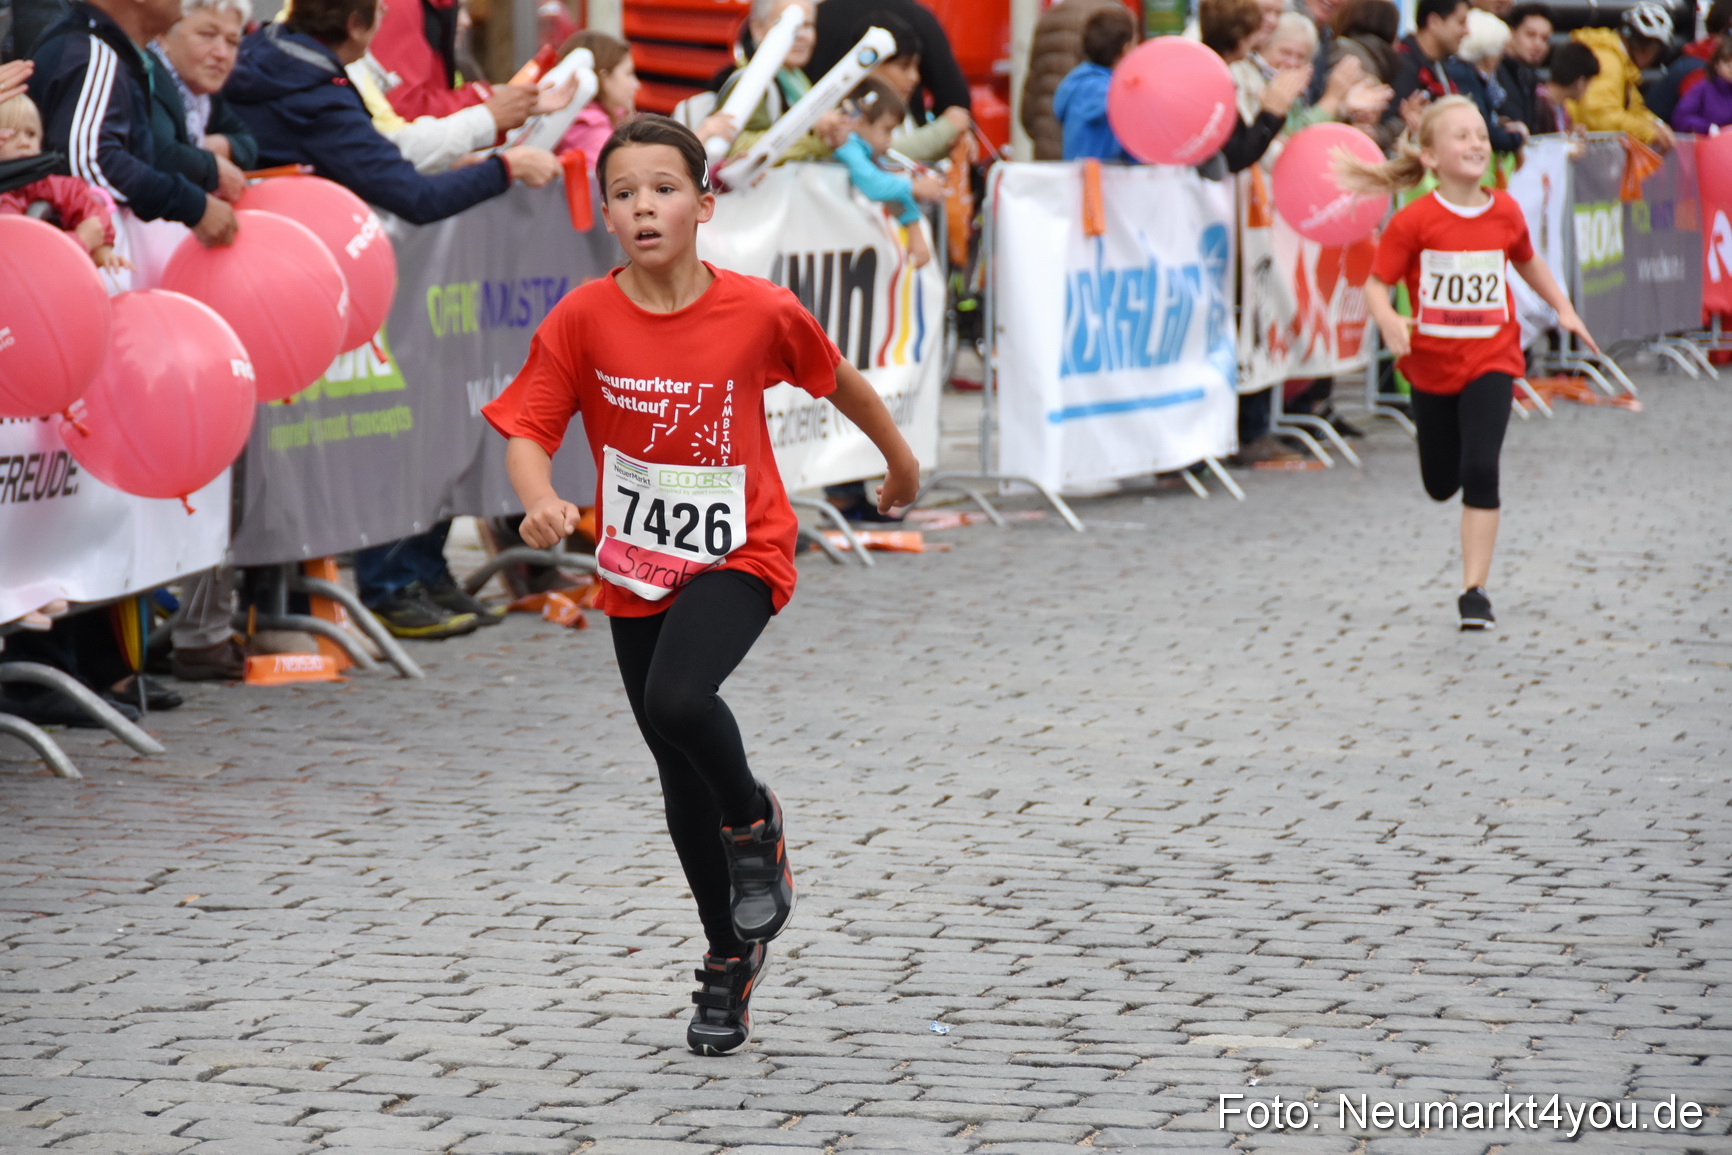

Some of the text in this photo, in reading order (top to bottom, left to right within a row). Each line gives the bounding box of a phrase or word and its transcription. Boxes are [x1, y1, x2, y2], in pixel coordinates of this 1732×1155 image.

[1430, 273, 1499, 304] 7032
[594, 368, 692, 394] Neumarkter
[601, 386, 670, 418] Stadtlauf
[720, 379, 734, 466] BAMBINI
[613, 464, 651, 486] NeuerMarkt
[658, 470, 734, 488] BOCK
[658, 487, 683, 495] inspired
[617, 485, 732, 557] 7426
